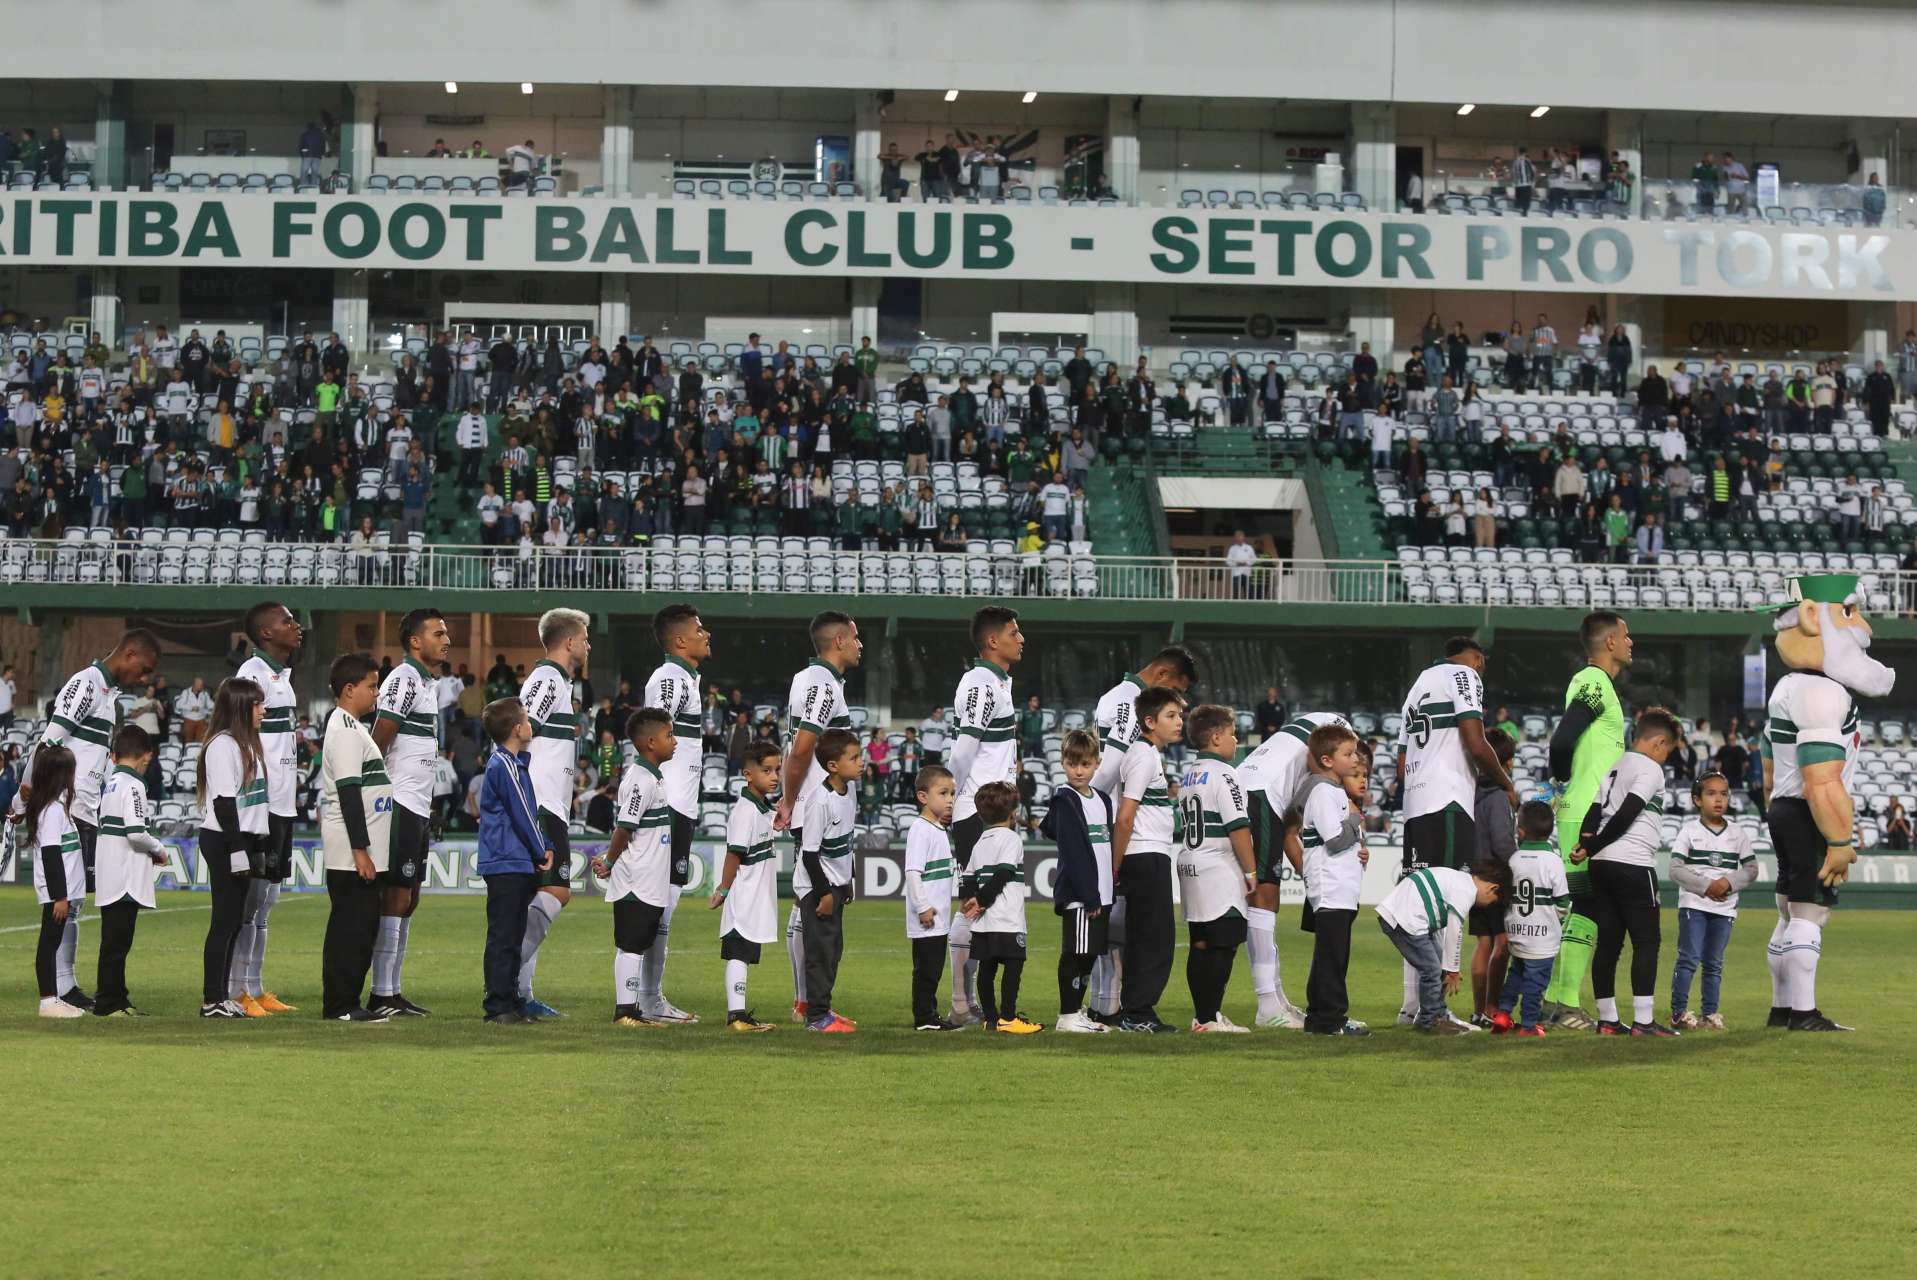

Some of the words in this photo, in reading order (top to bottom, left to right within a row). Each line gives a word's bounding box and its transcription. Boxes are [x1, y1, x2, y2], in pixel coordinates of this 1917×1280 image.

[0, 200, 241, 257] ITIBA
[273, 202, 503, 261] FOOT
[536, 206, 753, 264] BALL
[784, 209, 1015, 269] CLUB
[1149, 216, 1435, 281] SETOR
[1466, 225, 1635, 284] PRO
[1664, 228, 1896, 292] TORK
[1689, 320, 1819, 347] CANDYSHOP
[1453, 672, 1464, 696] TORK
[1459, 671, 1469, 691] PRO
[1181, 771, 1209, 788] AIXA
[1518, 878, 1535, 917] 9
[1507, 924, 1548, 937] LORENZO
